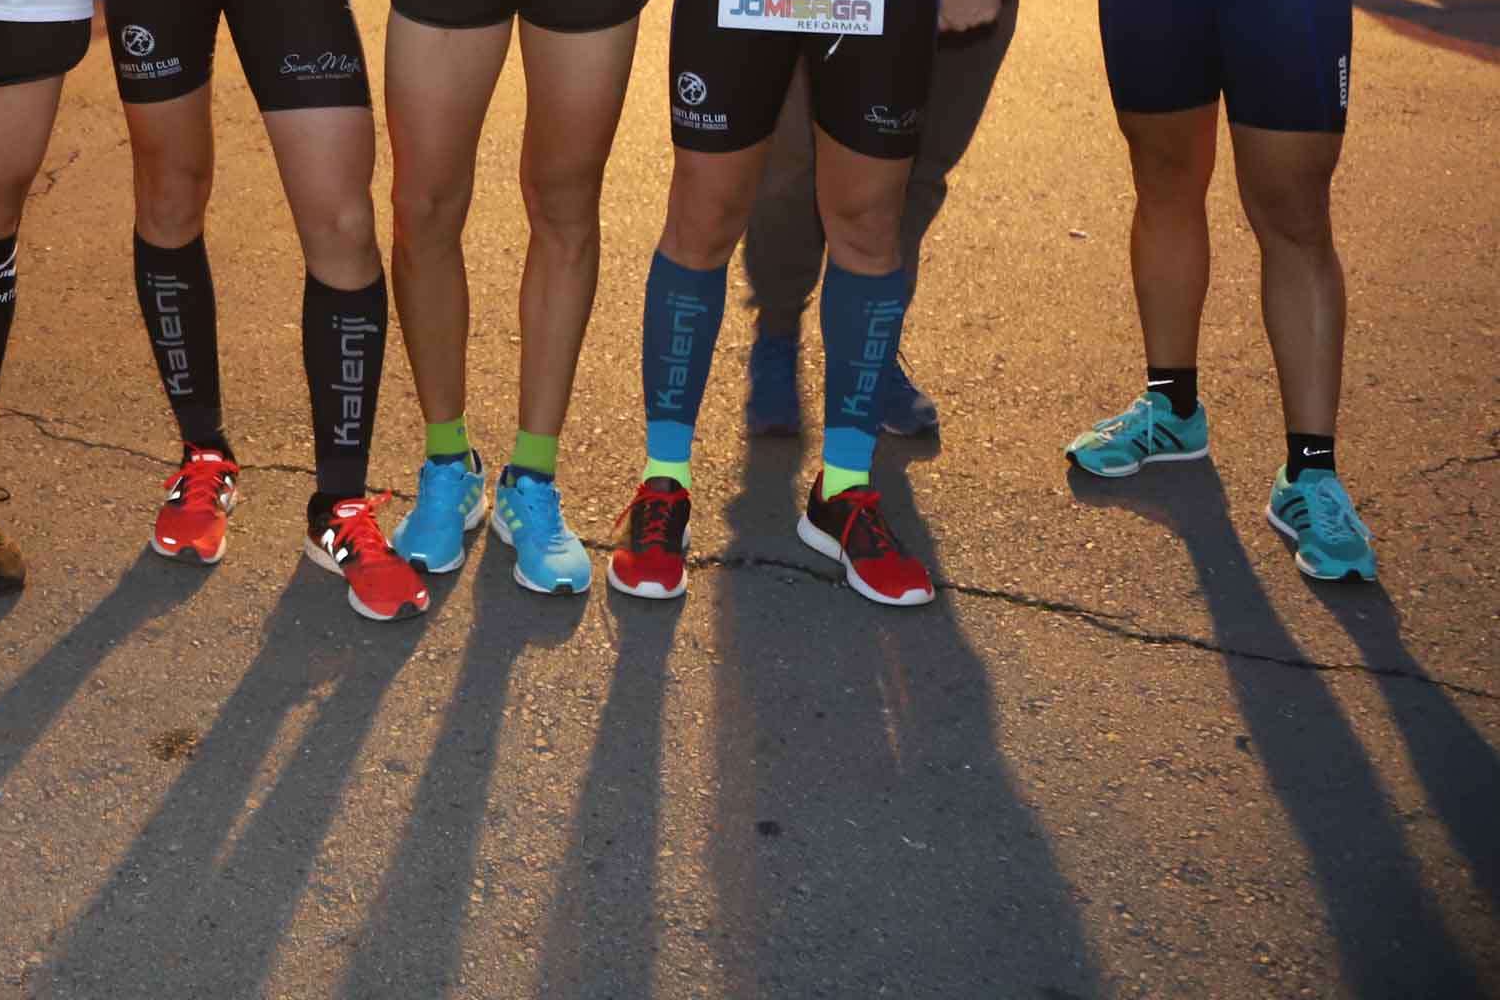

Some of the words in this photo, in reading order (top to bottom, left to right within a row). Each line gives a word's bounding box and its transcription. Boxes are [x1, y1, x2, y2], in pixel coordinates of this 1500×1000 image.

[156, 57, 180, 70] CLUB
[797, 20, 870, 32] REFORMAS
[703, 112, 727, 123] CLUB
[147, 272, 194, 396] kalenji
[331, 314, 378, 446] kalenji
[657, 294, 708, 410] kalenji
[841, 299, 904, 418] kalenji
